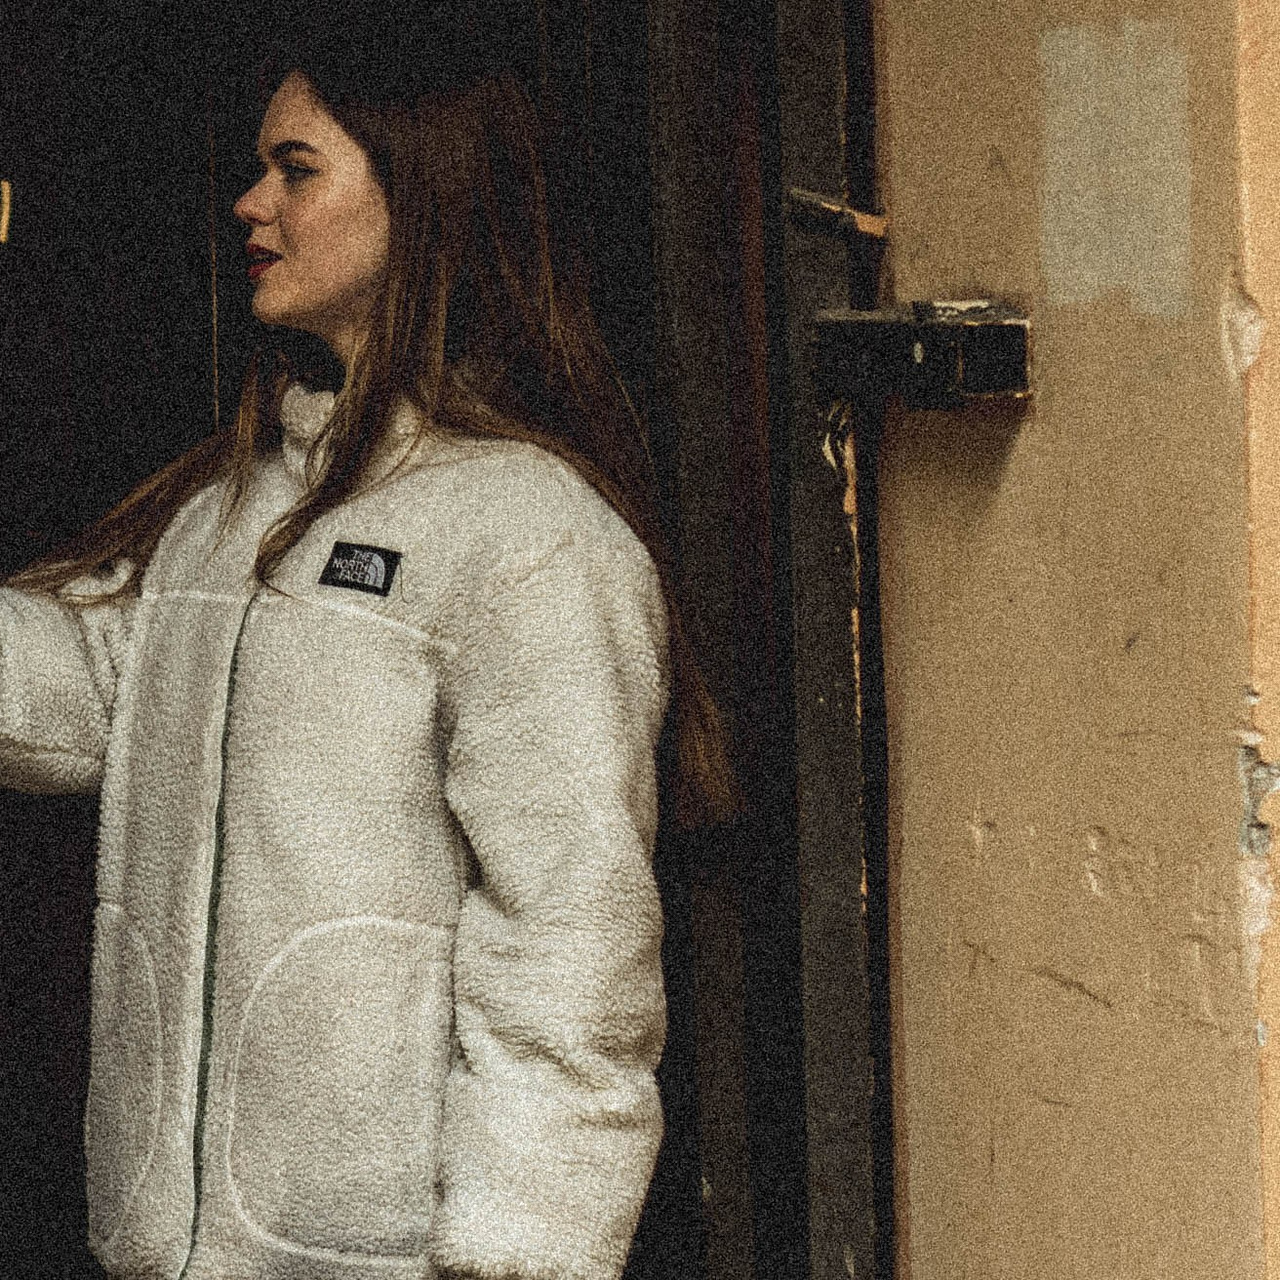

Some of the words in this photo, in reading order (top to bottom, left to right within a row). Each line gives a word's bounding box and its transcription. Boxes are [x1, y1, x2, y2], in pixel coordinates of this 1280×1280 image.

[353, 549, 374, 563] THE
[333, 557, 370, 571] NORTH
[339, 569, 366, 583] FACE
